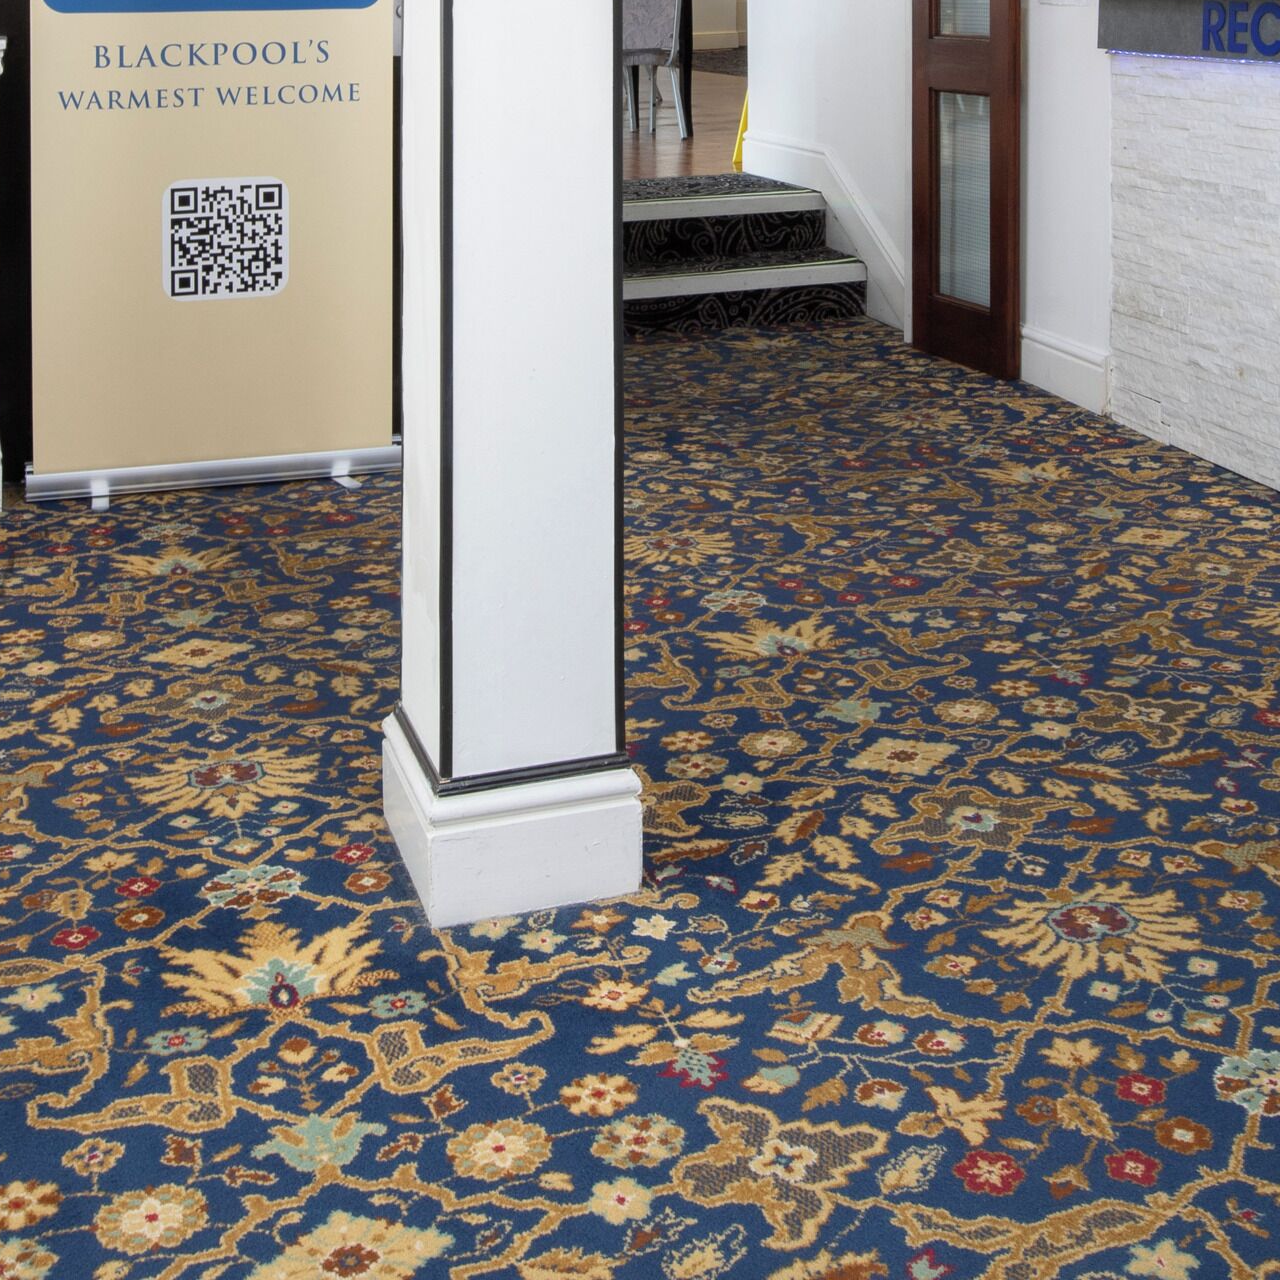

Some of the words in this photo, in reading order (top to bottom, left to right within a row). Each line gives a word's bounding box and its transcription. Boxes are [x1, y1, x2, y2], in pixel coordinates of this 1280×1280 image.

[93, 39, 330, 69] BLACKPOOL'S
[57, 86, 205, 111] WARMEST
[216, 82, 361, 106] WELCOME
